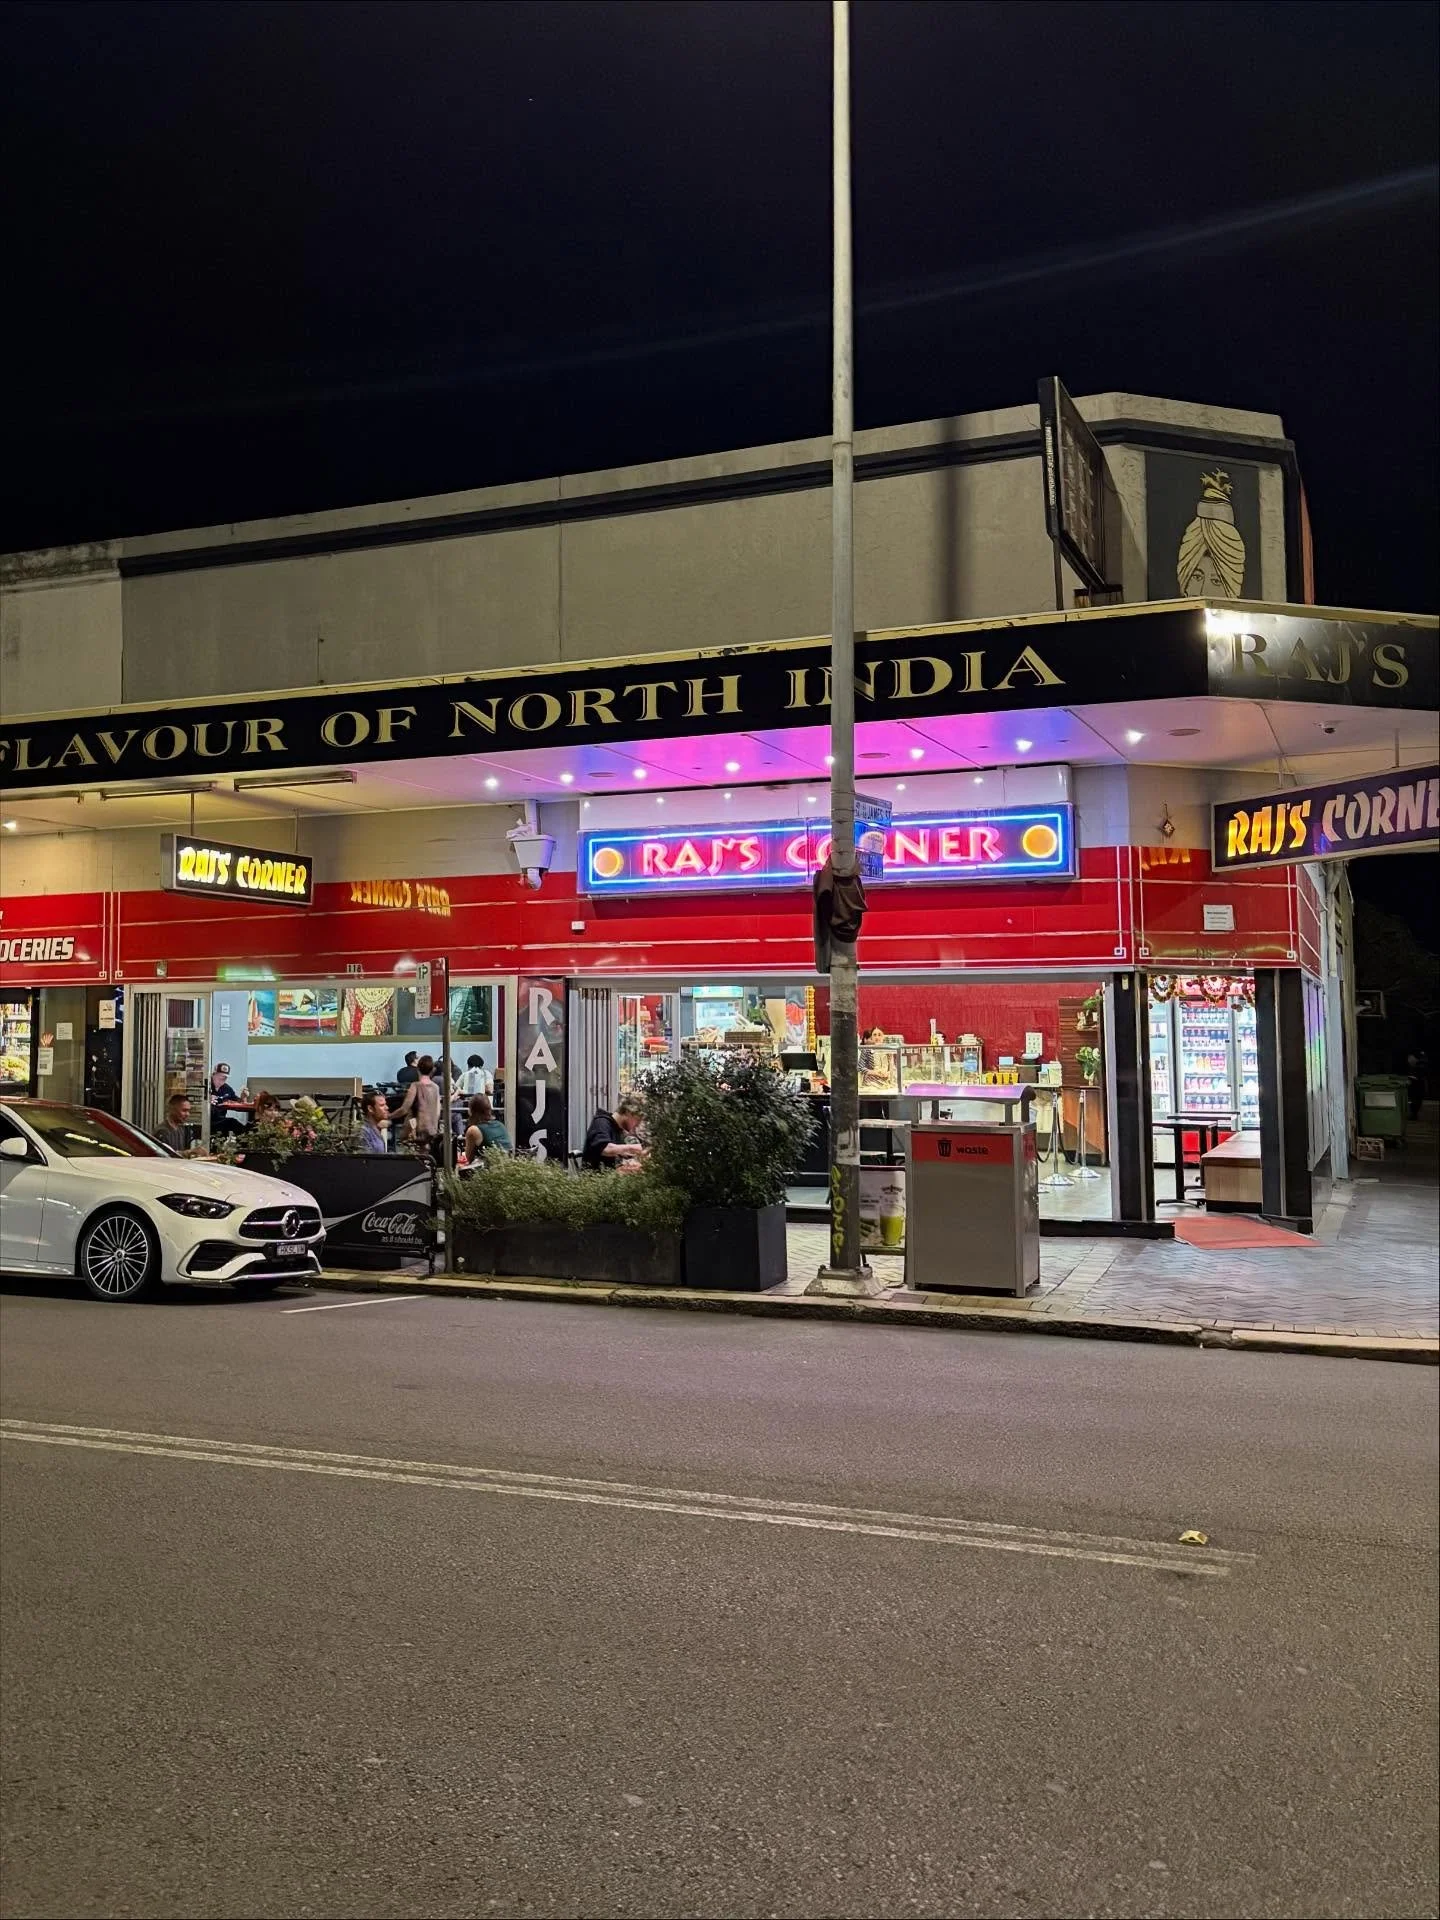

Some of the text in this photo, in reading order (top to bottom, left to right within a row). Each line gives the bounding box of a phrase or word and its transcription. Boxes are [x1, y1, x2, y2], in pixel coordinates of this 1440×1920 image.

[320, 706, 418, 748] OF
[448, 675, 743, 738] NORTH
[784, 645, 1066, 709] INDIA
[641, 826, 1004, 876] RAJ'S CNER
[1227, 800, 1312, 857] RAJ'S
[236, 855, 307, 895] CORNER
[0, 936, 75, 962] OCERIES
[956, 1146, 989, 1155] waste
